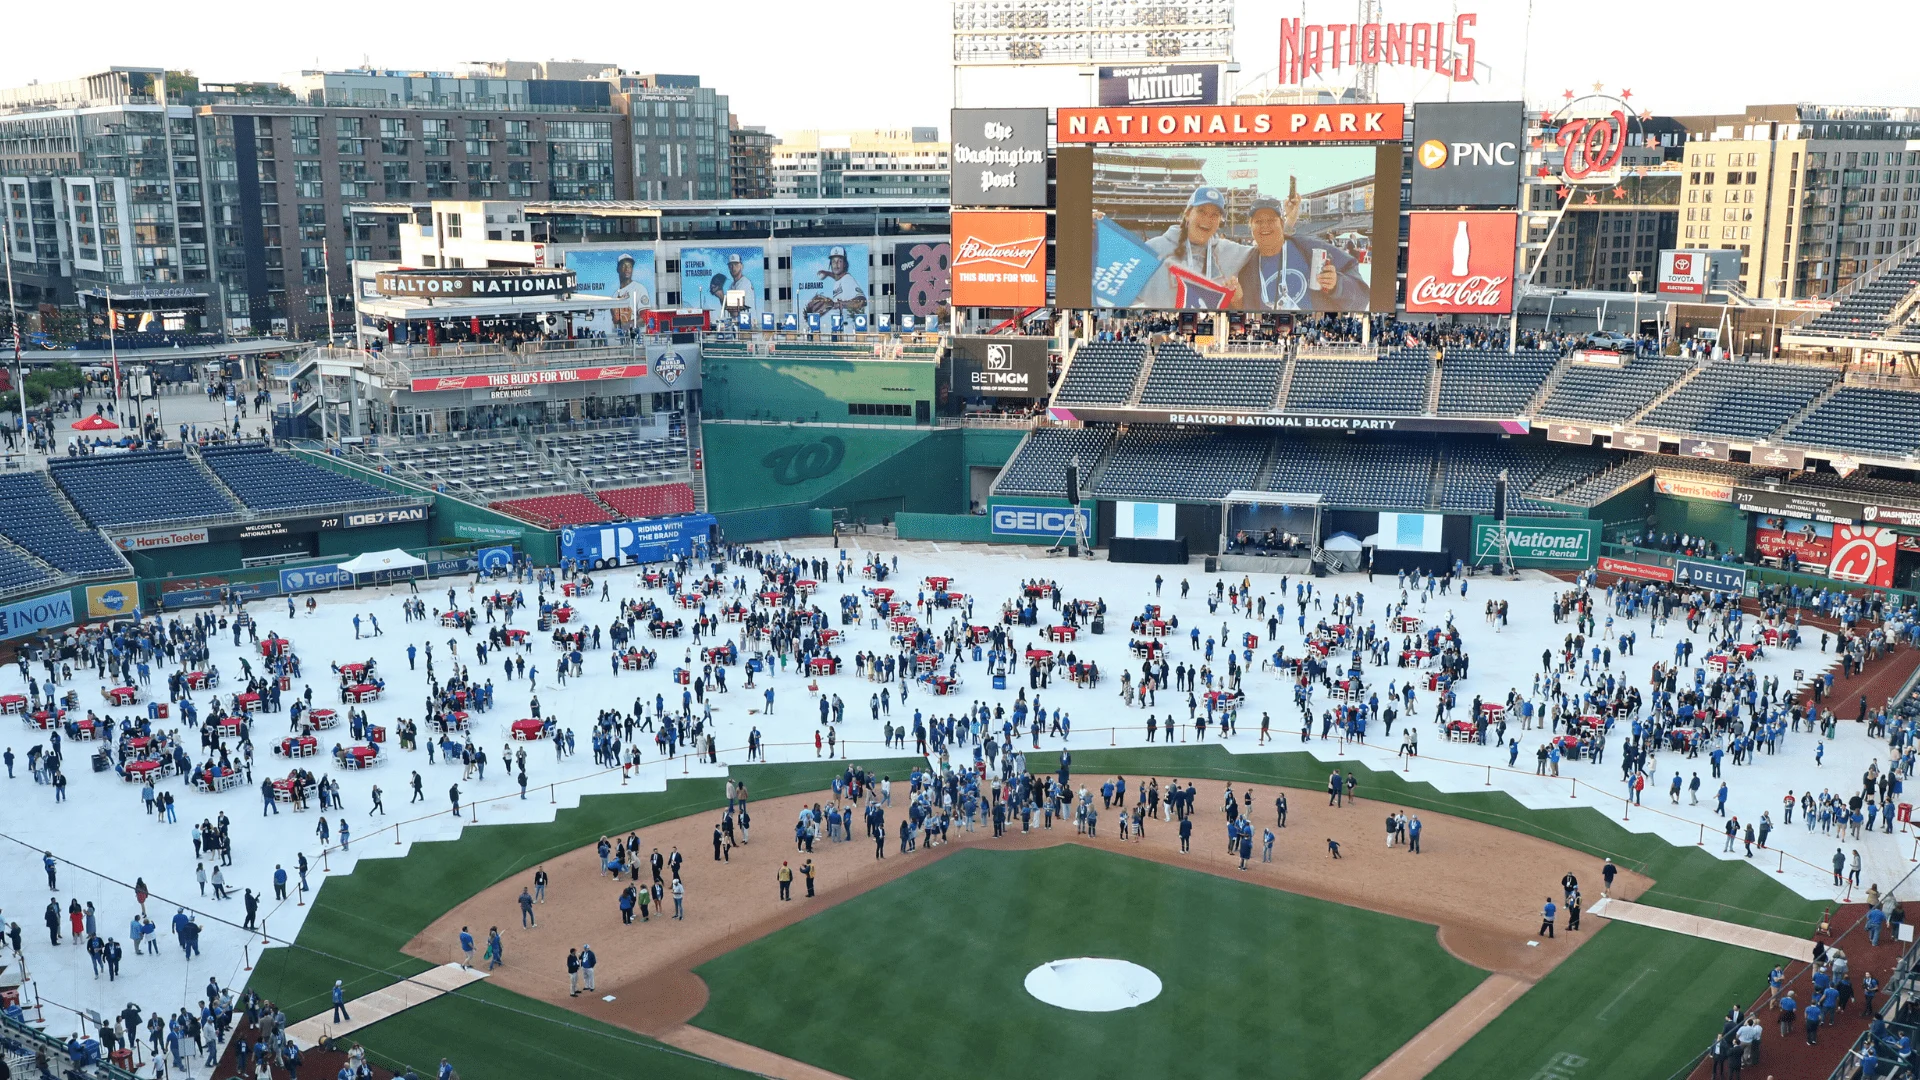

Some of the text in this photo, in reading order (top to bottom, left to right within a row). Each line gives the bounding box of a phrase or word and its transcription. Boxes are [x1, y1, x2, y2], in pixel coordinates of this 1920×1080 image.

[1278, 13, 1477, 84] NATIONALS
[1113, 66, 1167, 77] SHOW SOME
[1127, 73, 1203, 100] NATITUDE
[1069, 112, 1385, 135] NATIONALS PARK
[984, 121, 1013, 142] The
[954, 143, 1044, 167] Washington
[1450, 142, 1516, 166] PNC
[980, 170, 1017, 193] Post
[960, 243, 1034, 258] Budweiser
[685, 269, 713, 277] STRASBURG
[959, 273, 1038, 283] THIS BUD'S FOR YOU.
[1668, 275, 1695, 283] TOYOTA
[472, 276, 563, 293] NATIONAL
[592, 282, 605, 291] GRAY
[799, 281, 824, 290] CJ ABRAMS
[1411, 275, 1507, 306] Coca-Cola
[163, 287, 197, 297] SOCIAL
[487, 375, 508, 386] THIS
[511, 373, 537, 385] BUD'S
[540, 371, 557, 382] FOR
[559, 370, 579, 381] YOU.
[971, 372, 1029, 384] BETMGM
[490, 389, 532, 399] BREW HOUSE
[1236, 415, 1302, 427] NATIONAL
[1305, 417, 1349, 428] BLOCK
[1353, 419, 1397, 430] PARTY
[1673, 483, 1730, 499] Harris Teeter
[1737, 493, 1753, 502] 7:17
[1791, 498, 1818, 507] WELCOME
[388, 508, 423, 522] FAN
[1739, 503, 1767, 514] NATIONALS
[1768, 507, 1812, 520] PHILANTHROPIES
[1785, 504, 1832, 515] NATIONALS PARK!
[320, 519, 338, 528] 7:17
[995, 510, 1088, 532] GEICO
[240, 528, 288, 538] NATIONALS PARK!
[506, 528, 521, 536] Office
[638, 522, 683, 534] RIDING WITH
[136, 531, 206, 548] Harris Teeter
[638, 531, 680, 541] THE BRAND
[1531, 549, 1578, 558] Car Rental
[437, 561, 459, 570] MGM
[1613, 563, 1668, 578] Raytheon Technologies
[386, 569, 411, 578] CLEAR
[1694, 569, 1742, 588] DELTA
[96, 595, 129, 604] Pedigree
[1889, 593, 1900, 604] 335
[13, 600, 71, 629] INOVA
